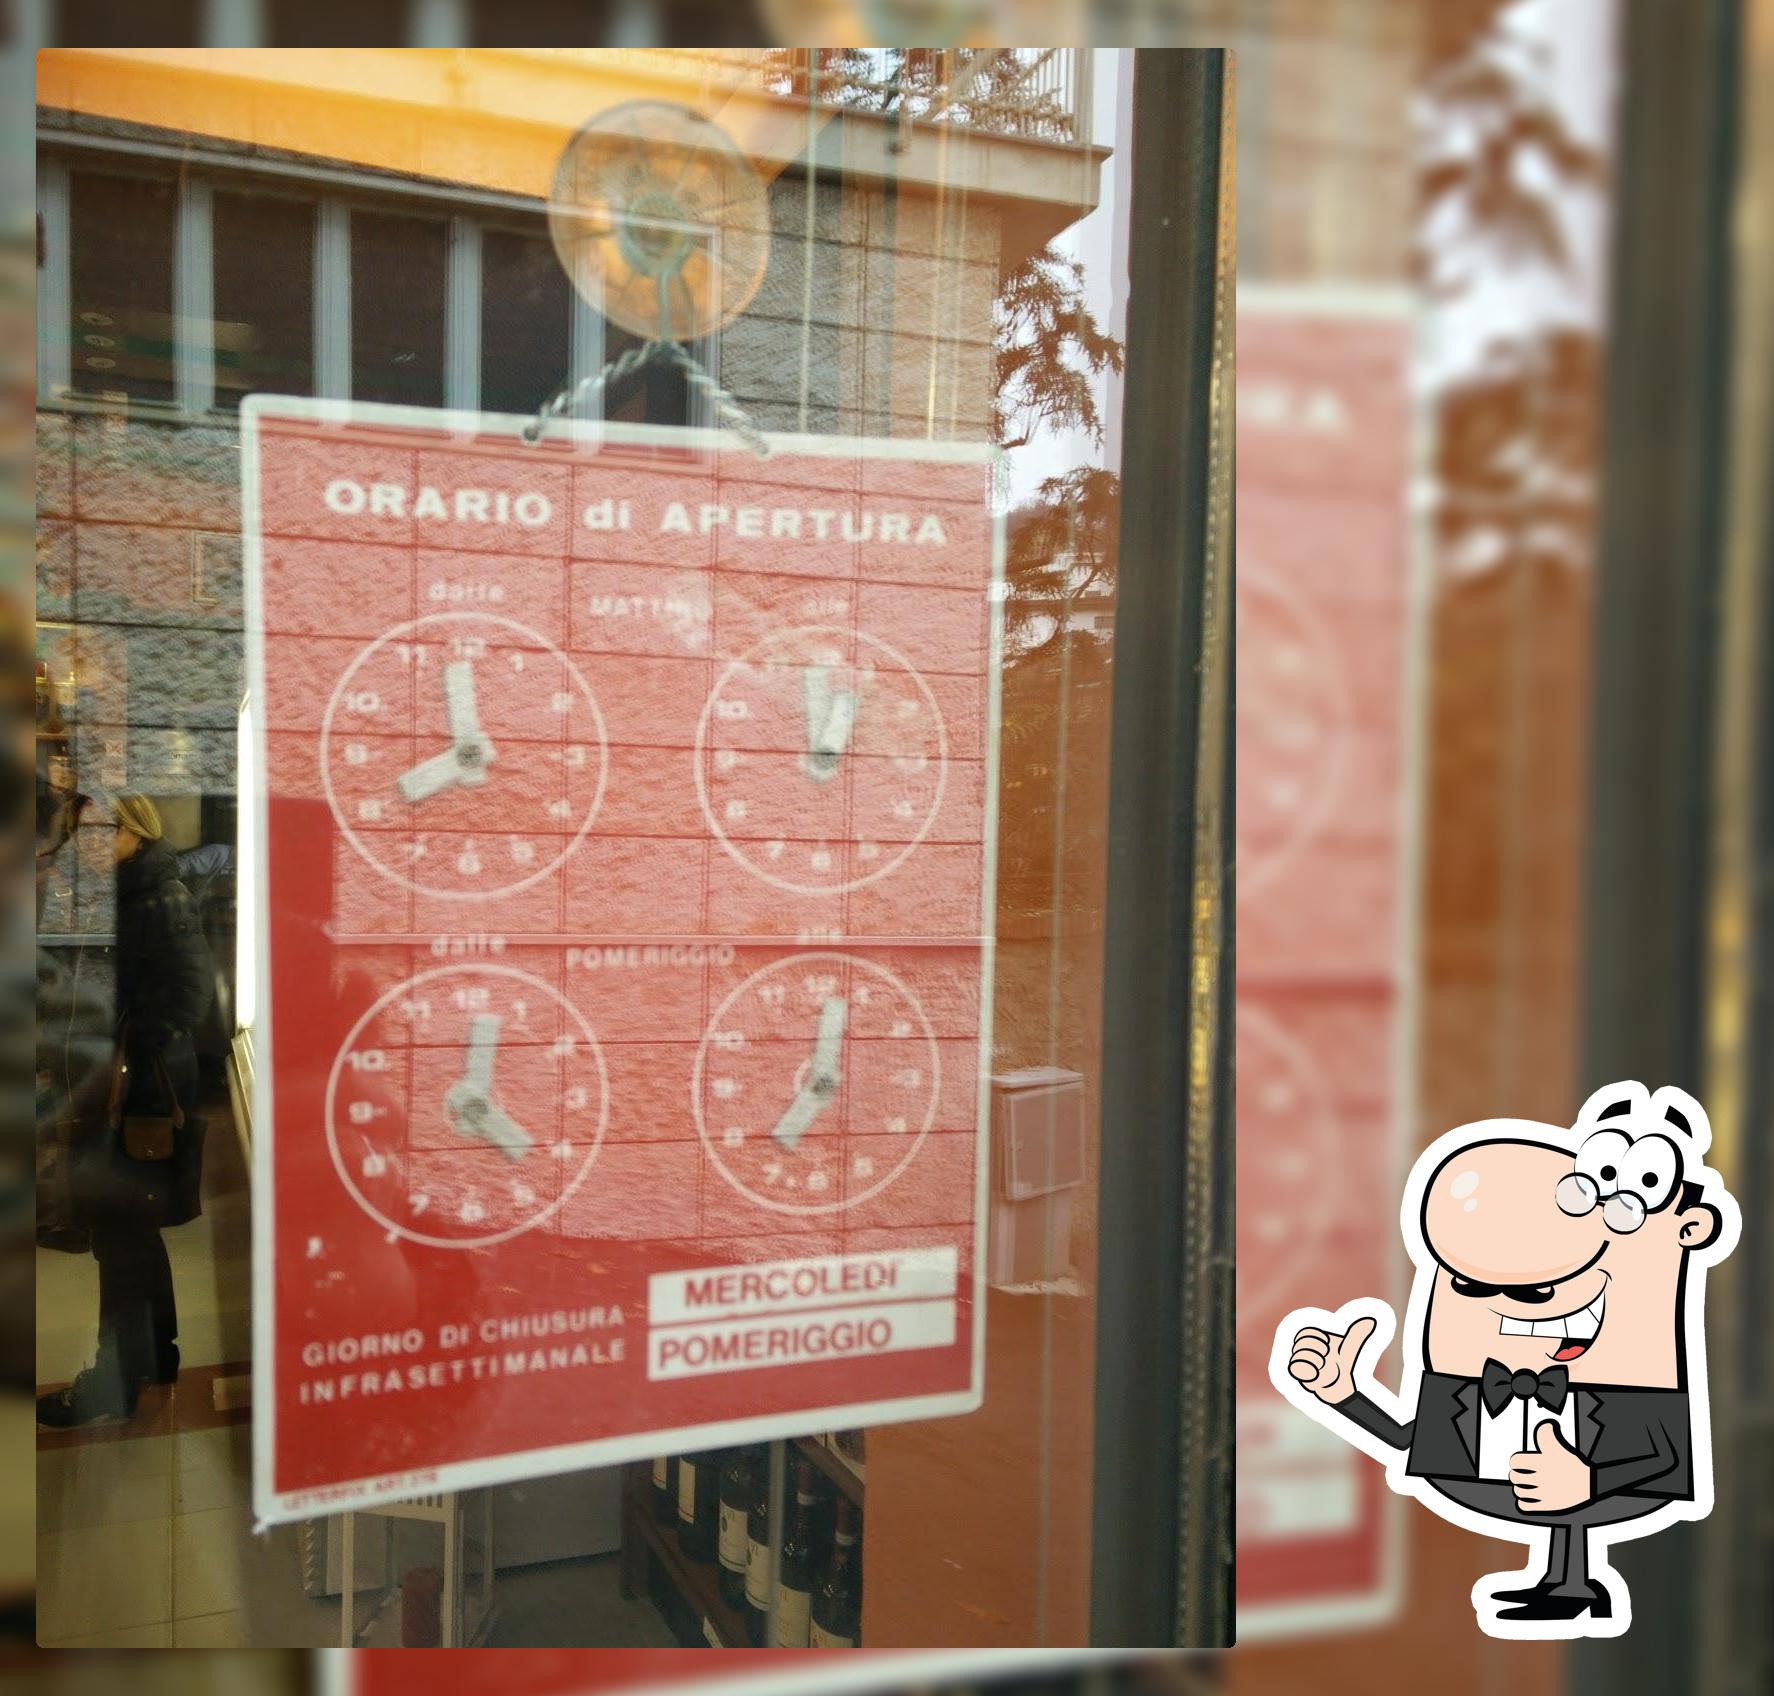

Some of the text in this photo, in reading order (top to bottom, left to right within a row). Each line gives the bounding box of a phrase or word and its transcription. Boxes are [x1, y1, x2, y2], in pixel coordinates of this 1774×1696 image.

[324, 478, 948, 546] ORARIO di APERTURA
[428, 580, 506, 603] dalle
[452, 636, 486, 658] 12
[714, 698, 748, 721] 10
[430, 933, 507, 957] dalle
[565, 943, 737, 971] POMERIGGIO
[346, 1047, 387, 1073] 10
[349, 1100, 375, 1125] 9
[684, 1258, 898, 1309] MERCOLEDI
[302, 1304, 625, 1368] GIORNO DI CHIUSURA
[658, 1317, 893, 1370] POMERIGGIO
[300, 1337, 626, 1406] INFRASETTIMANALE
